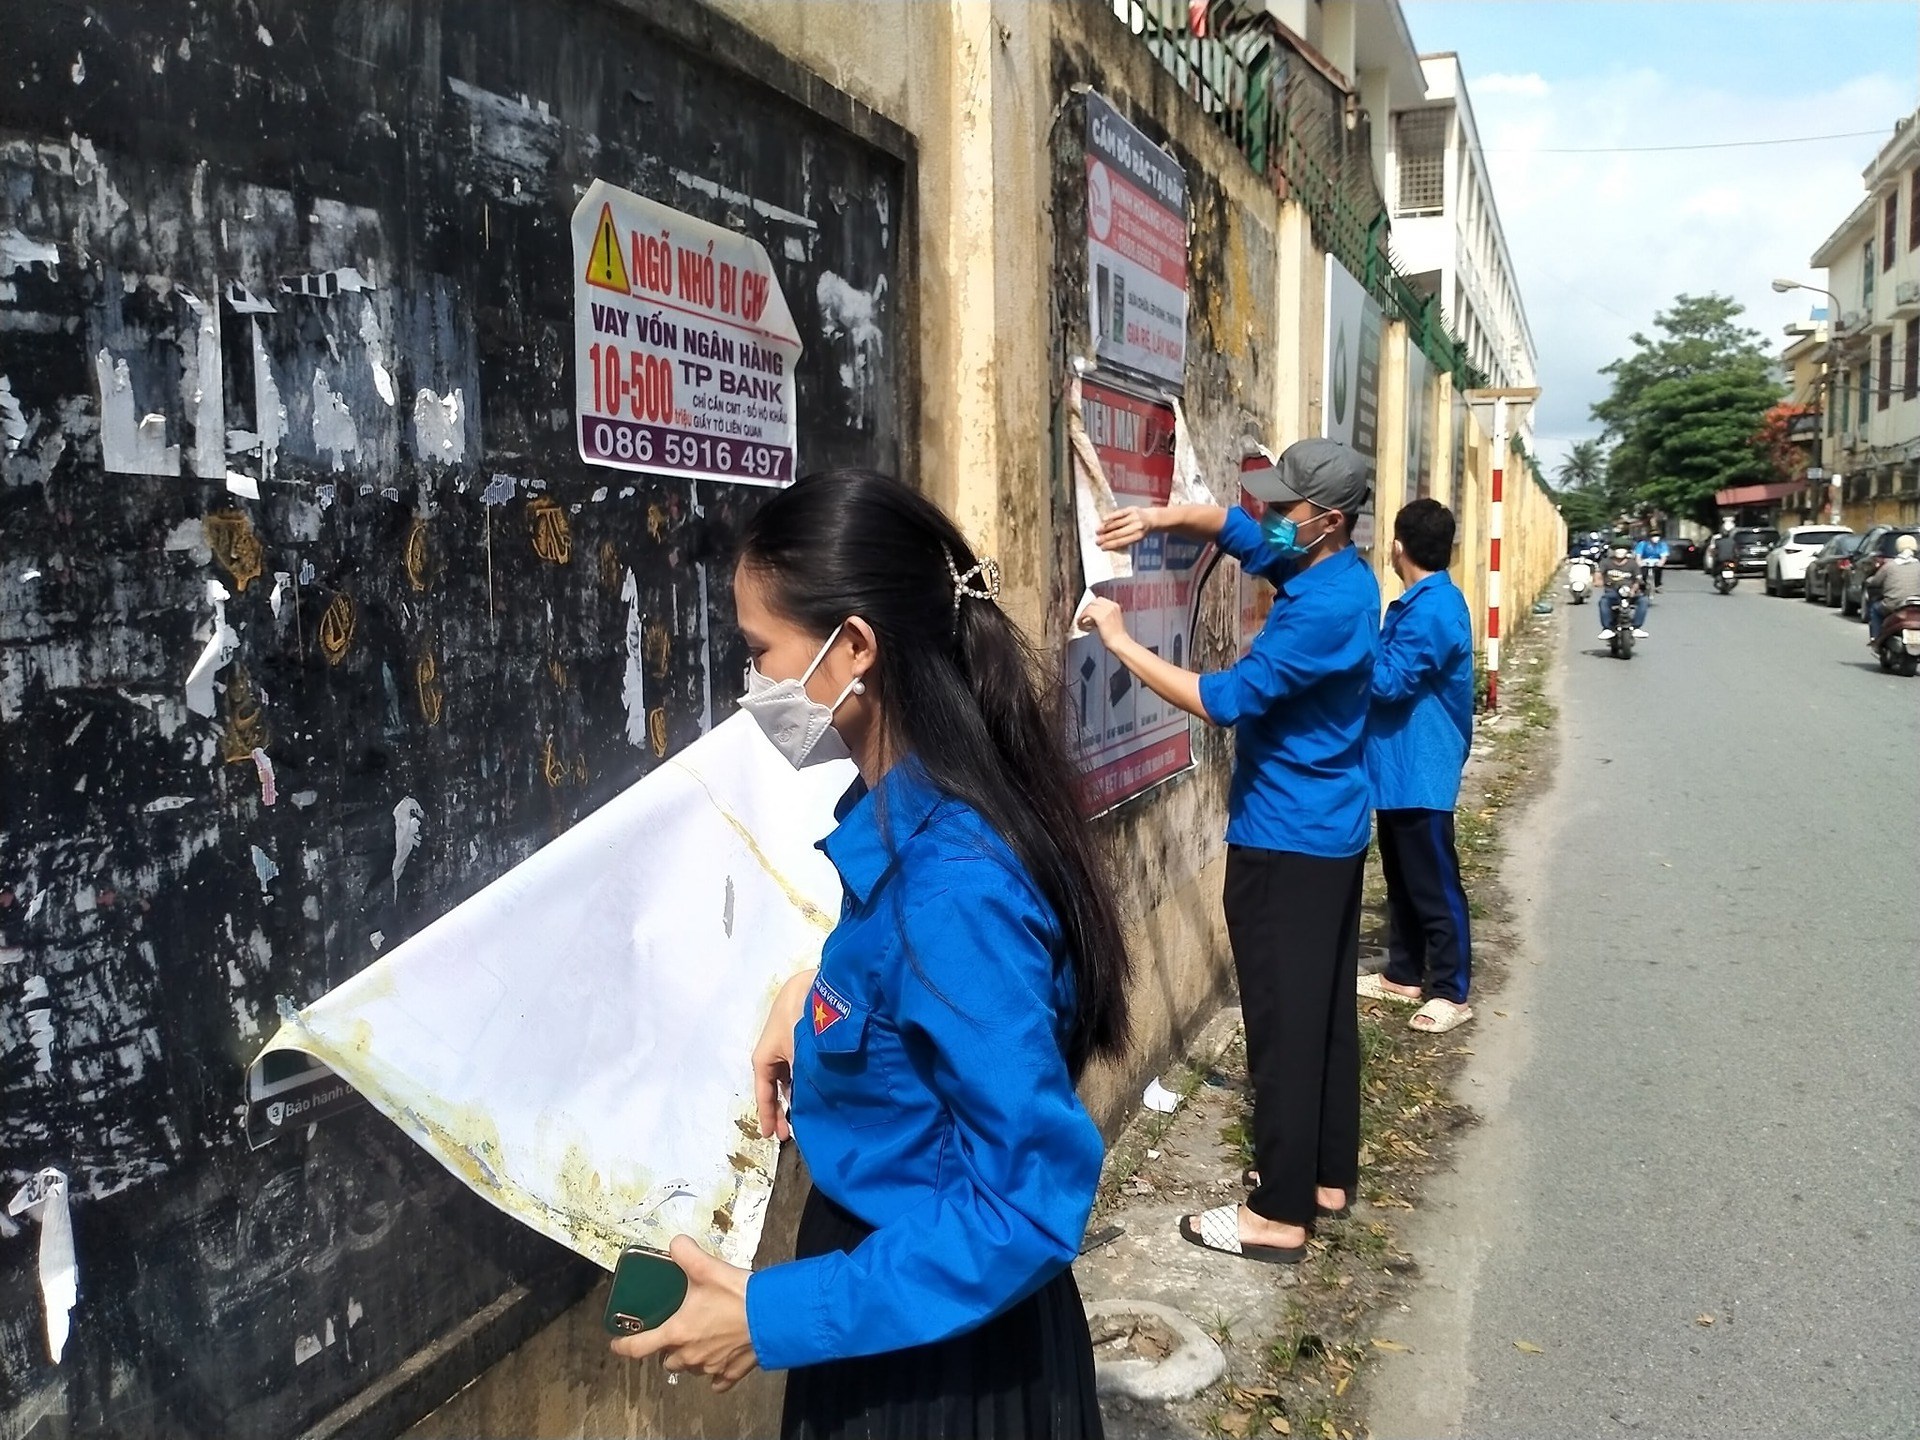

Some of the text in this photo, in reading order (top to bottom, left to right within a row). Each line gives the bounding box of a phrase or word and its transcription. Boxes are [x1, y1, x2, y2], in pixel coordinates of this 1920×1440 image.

[632, 231, 672, 296] NGÕ
[678, 240, 714, 309] NHỎ
[719, 262, 737, 316] ĐI
[591, 302, 783, 376] VAY VỐN NGÂN HÀNG
[589, 342, 692, 429] 10-500 triệu
[678, 359, 784, 406] TP BANK
[693, 413, 711, 429] GIẤY
[725, 419, 742, 435] LIÊN
[743, 424, 762, 437] QUAN
[725, 401, 741, 415] CMT
[594, 423, 785, 478] 086 5916 497
[272, 1105, 280, 1118] 3
[285, 1097, 310, 1117] Bảo
